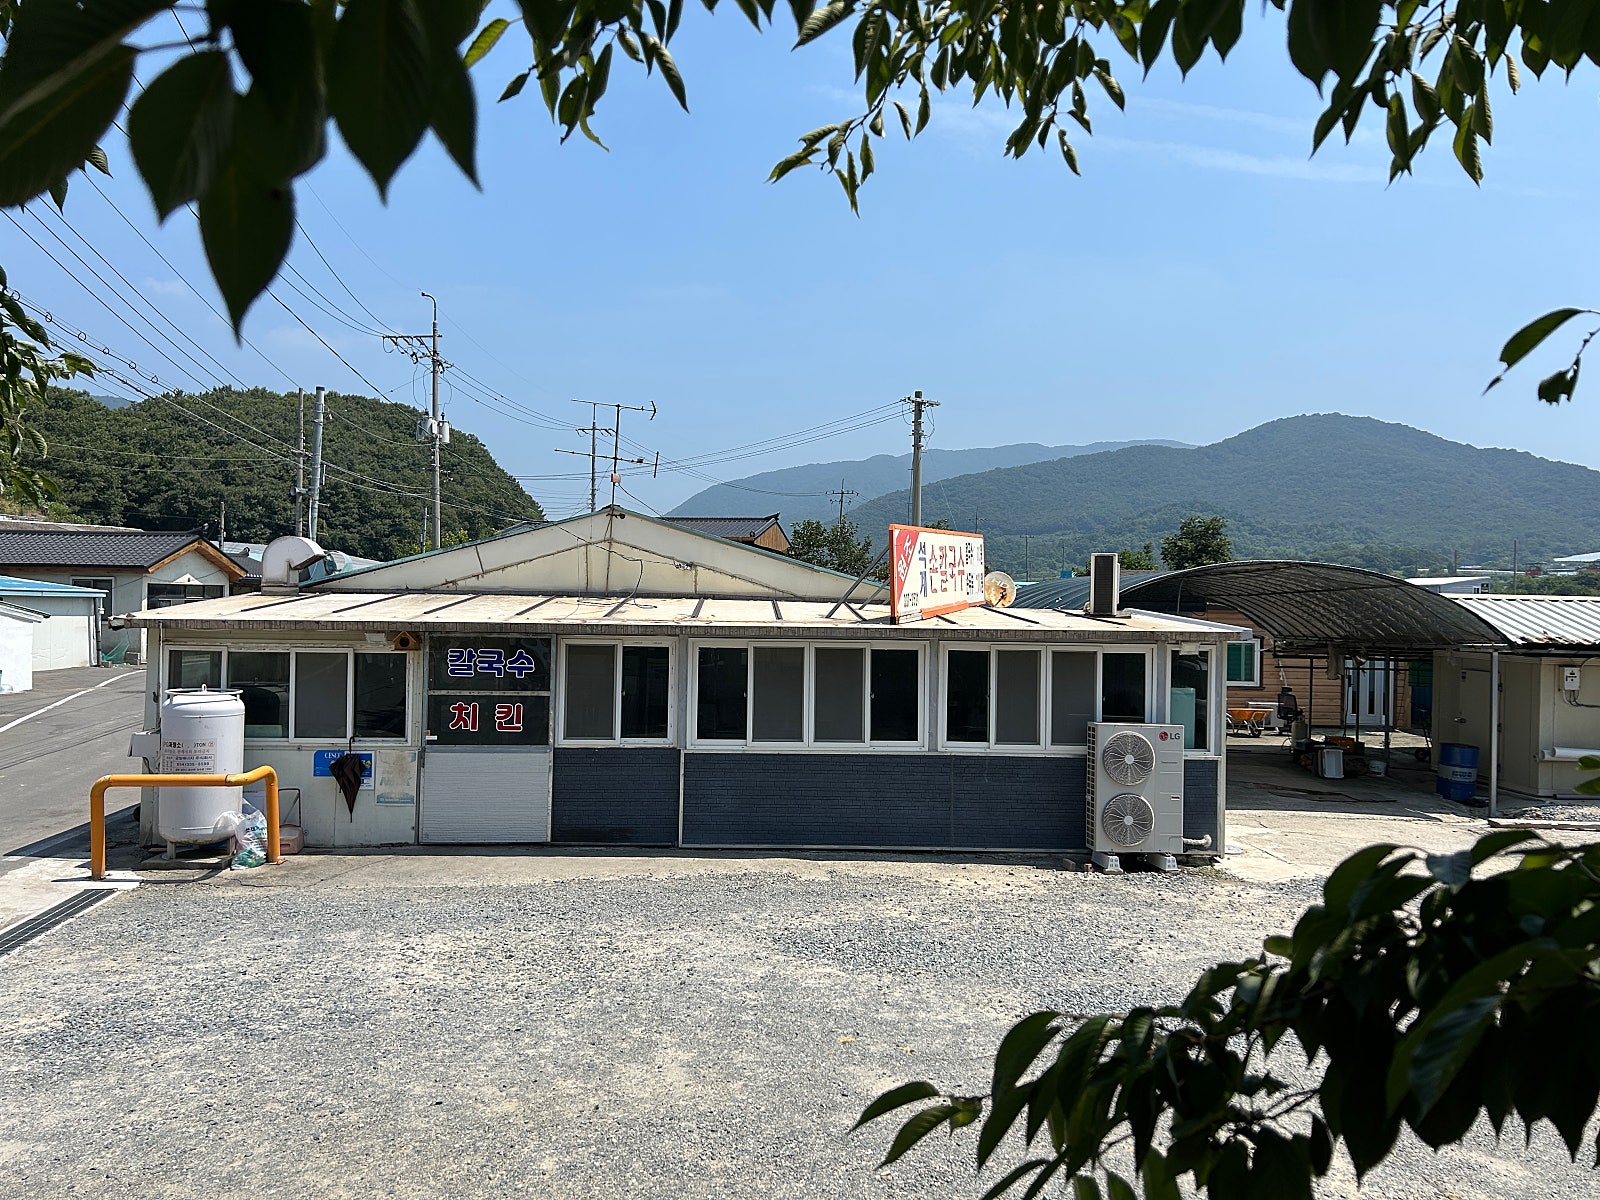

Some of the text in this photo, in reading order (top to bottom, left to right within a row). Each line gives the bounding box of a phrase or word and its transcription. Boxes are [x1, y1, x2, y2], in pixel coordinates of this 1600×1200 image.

[929, 544, 965, 594] 손칼국수
[447, 648, 535, 678] 칼국수
[1170, 732, 1181, 740] LG
